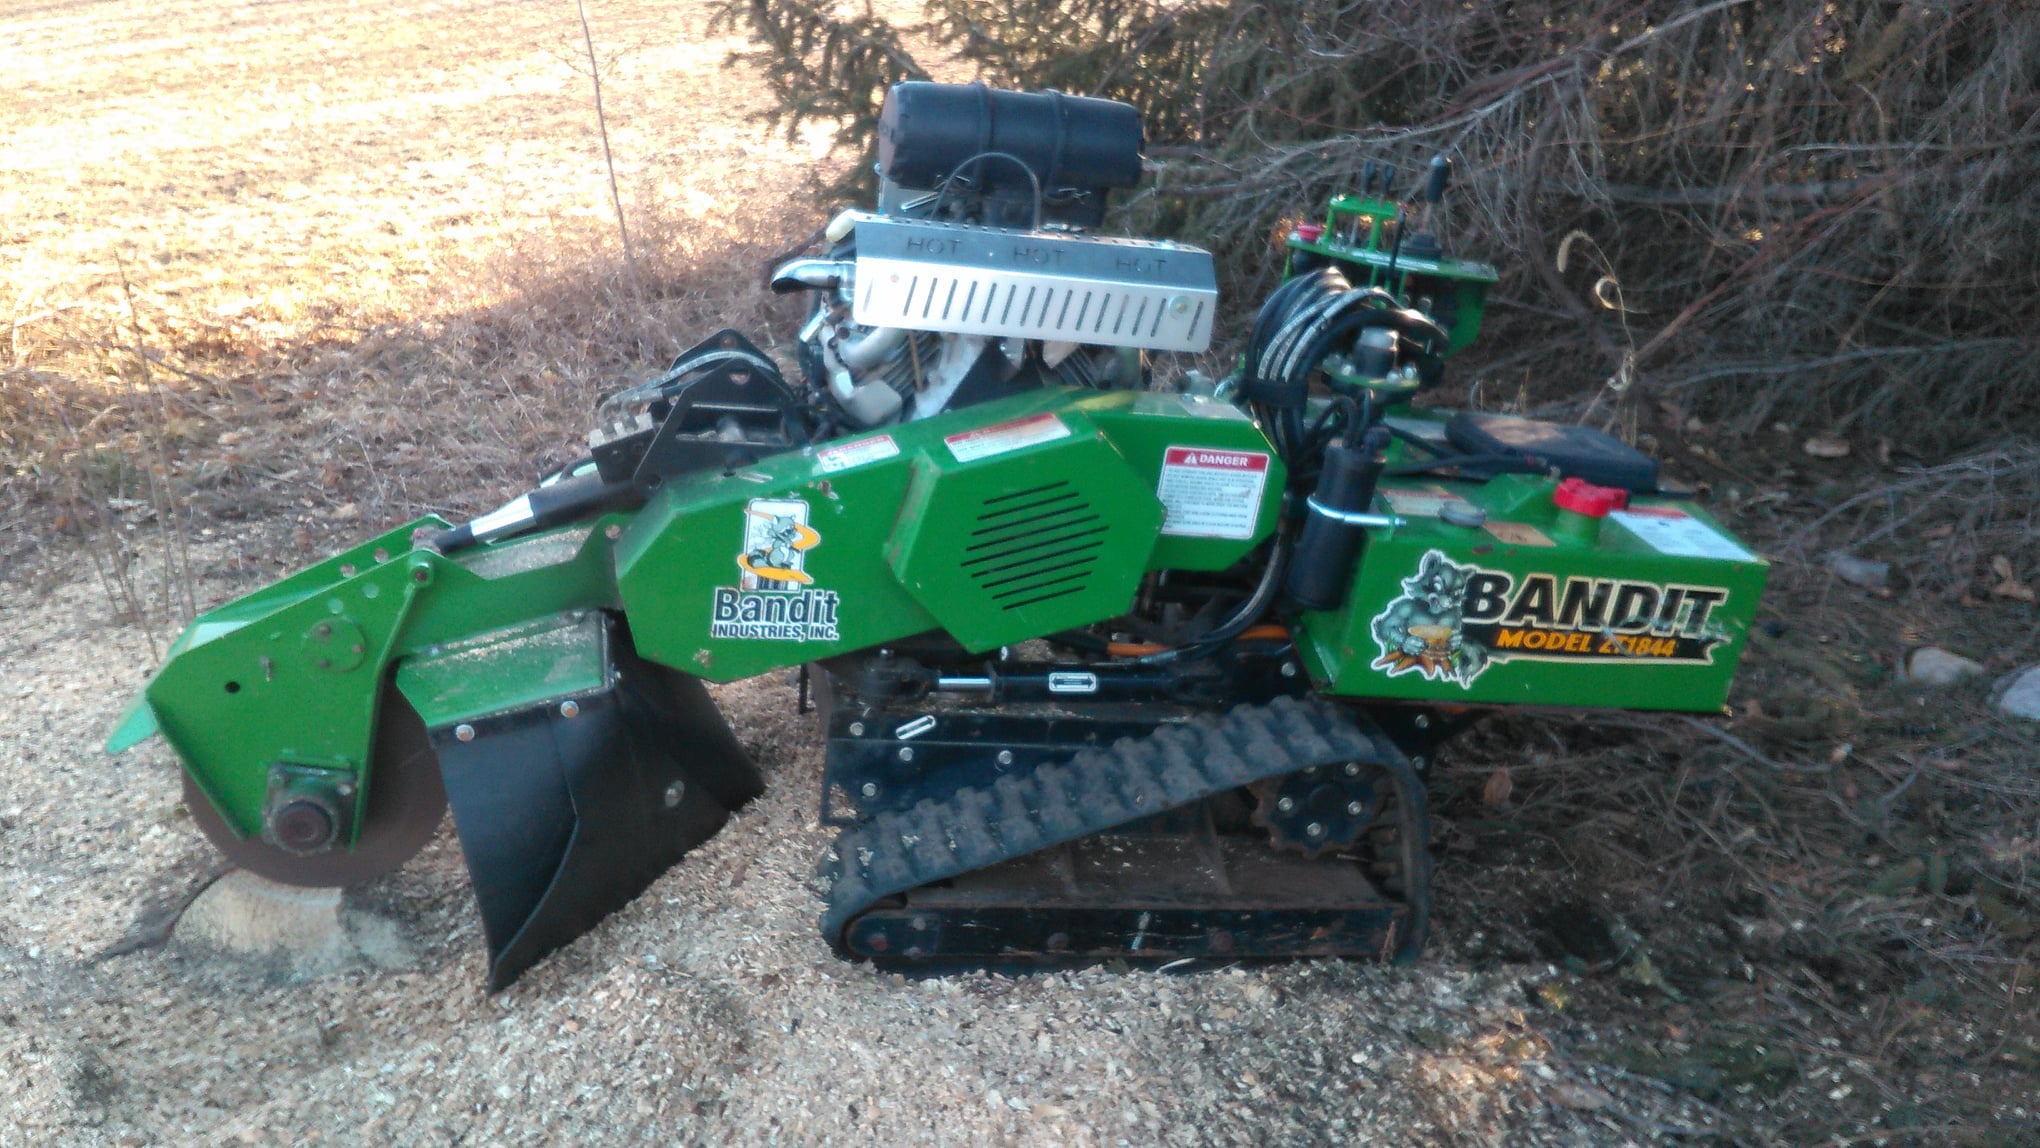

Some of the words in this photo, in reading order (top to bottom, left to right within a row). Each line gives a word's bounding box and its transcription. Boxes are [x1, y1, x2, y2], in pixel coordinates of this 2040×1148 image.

[907, 237, 961, 255] HOT
[1013, 247, 1065, 265] HOT
[1115, 257, 1168, 273] HOT
[1199, 453, 1248, 467] DANGER
[714, 587, 839, 624] Bandit
[1462, 568, 1729, 637] BANDIT
[713, 624, 805, 641] INDUSTRIES,
[810, 625, 839, 639] INC.
[1496, 629, 1591, 653] MODEL
